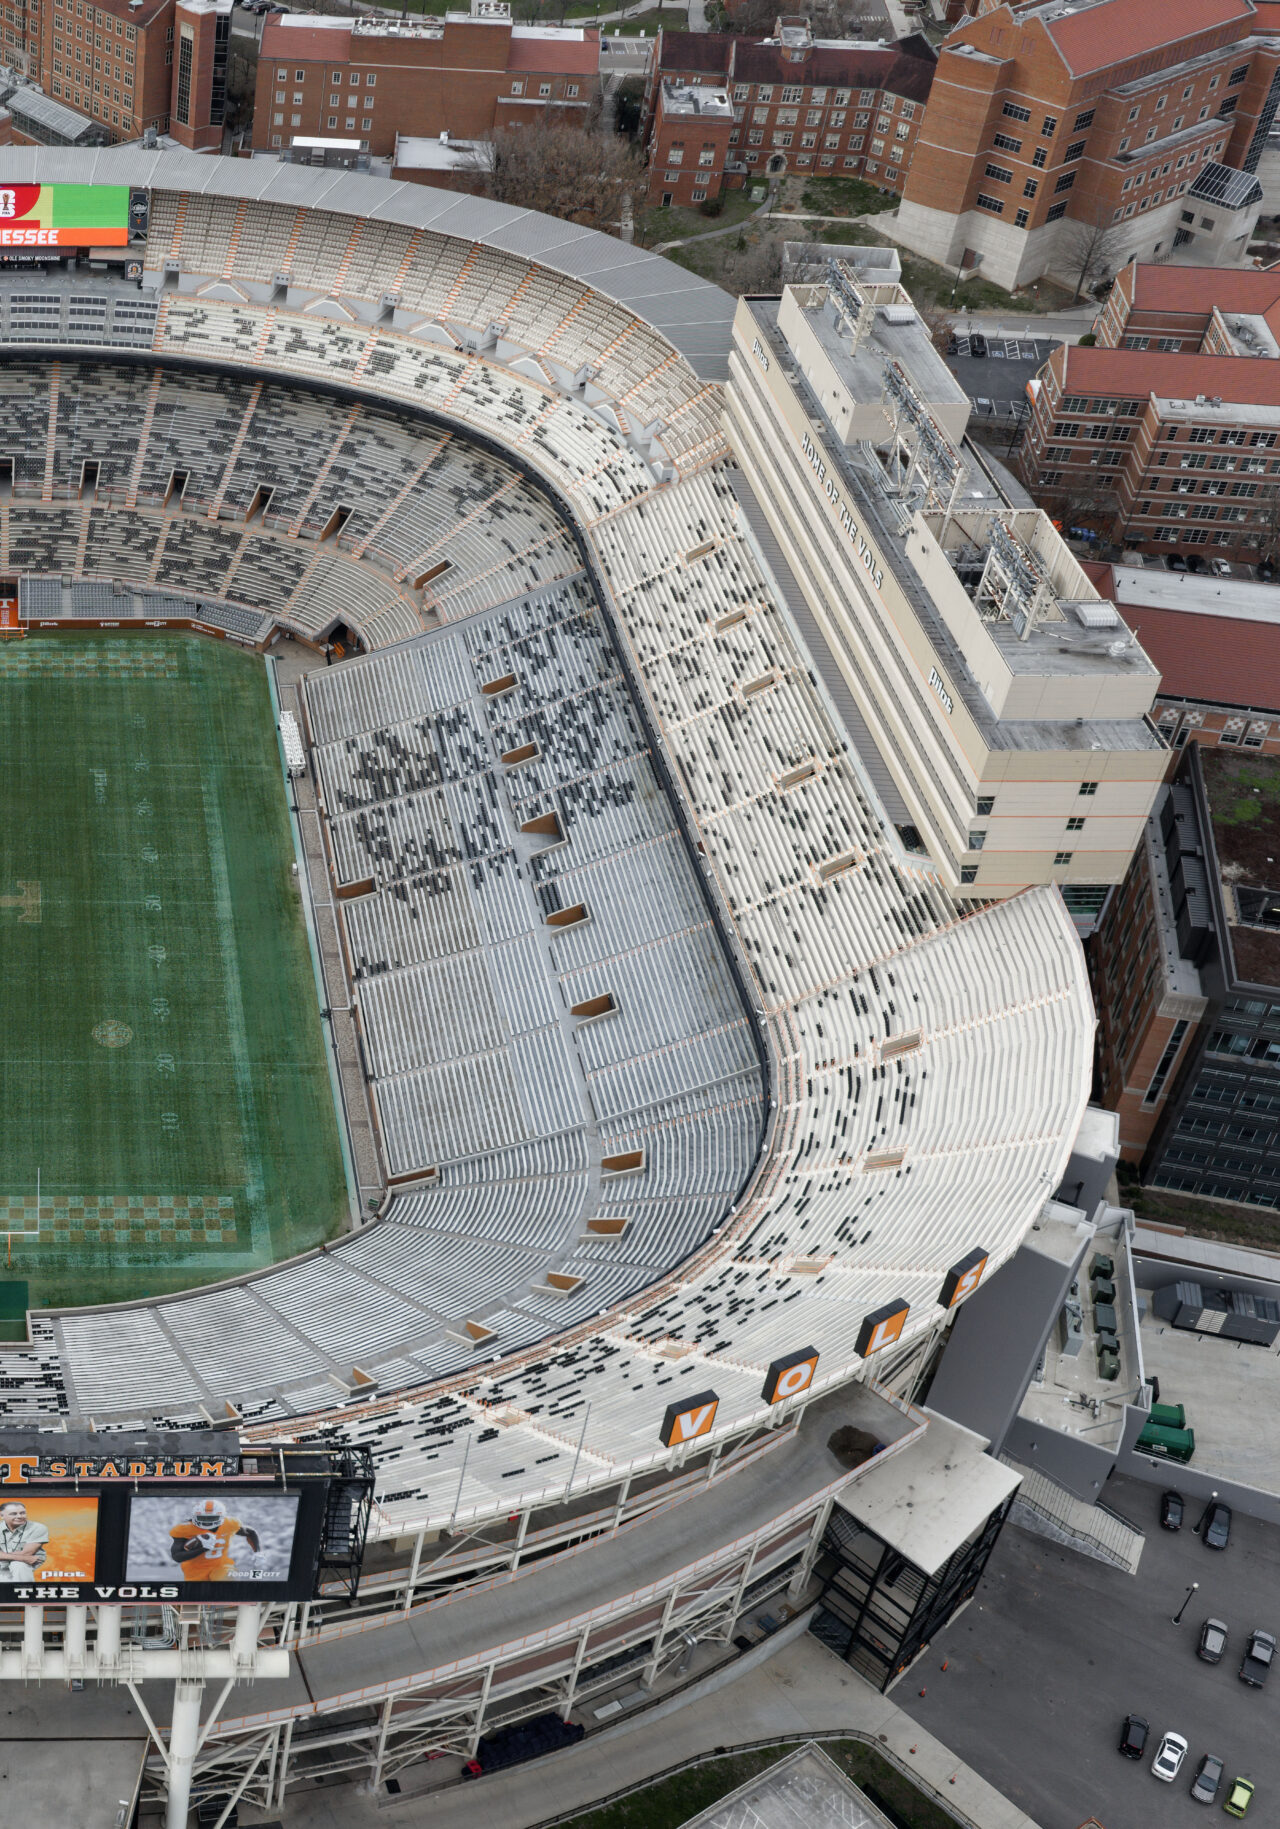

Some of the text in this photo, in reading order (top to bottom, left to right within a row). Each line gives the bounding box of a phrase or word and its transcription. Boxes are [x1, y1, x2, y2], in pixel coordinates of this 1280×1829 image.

[802, 431, 884, 590] HOME OF THE VOLS
[928, 665, 954, 715] pilot
[145, 894, 161, 911] 50
[157, 1053, 175, 1072] 20
[50, 1461, 225, 1477] STADIUM
[41, 1570, 86, 1580] pilot
[14, 1587, 80, 1599] THE
[94, 1587, 179, 1598] VOLS
